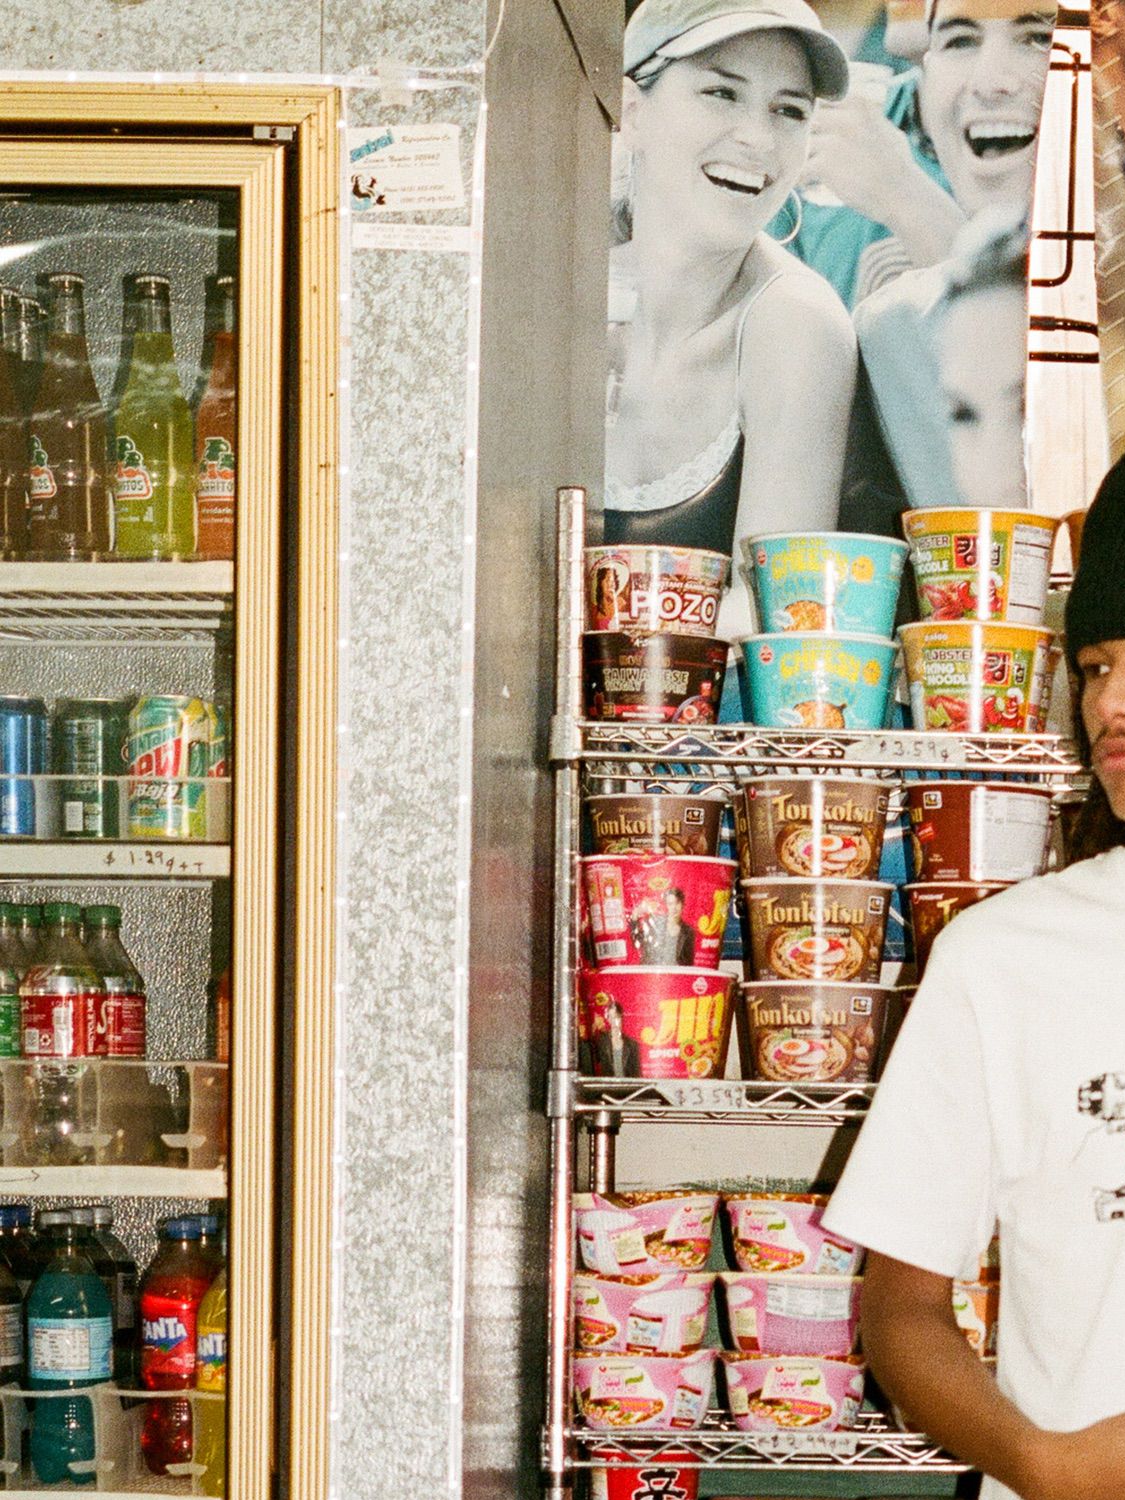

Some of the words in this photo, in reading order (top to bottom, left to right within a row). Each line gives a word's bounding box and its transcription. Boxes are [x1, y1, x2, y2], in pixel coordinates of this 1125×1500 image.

[628, 588, 718, 626] POZO
[761, 896, 865, 926] Tonkotsu
[142, 1316, 188, 1340] ANTA
